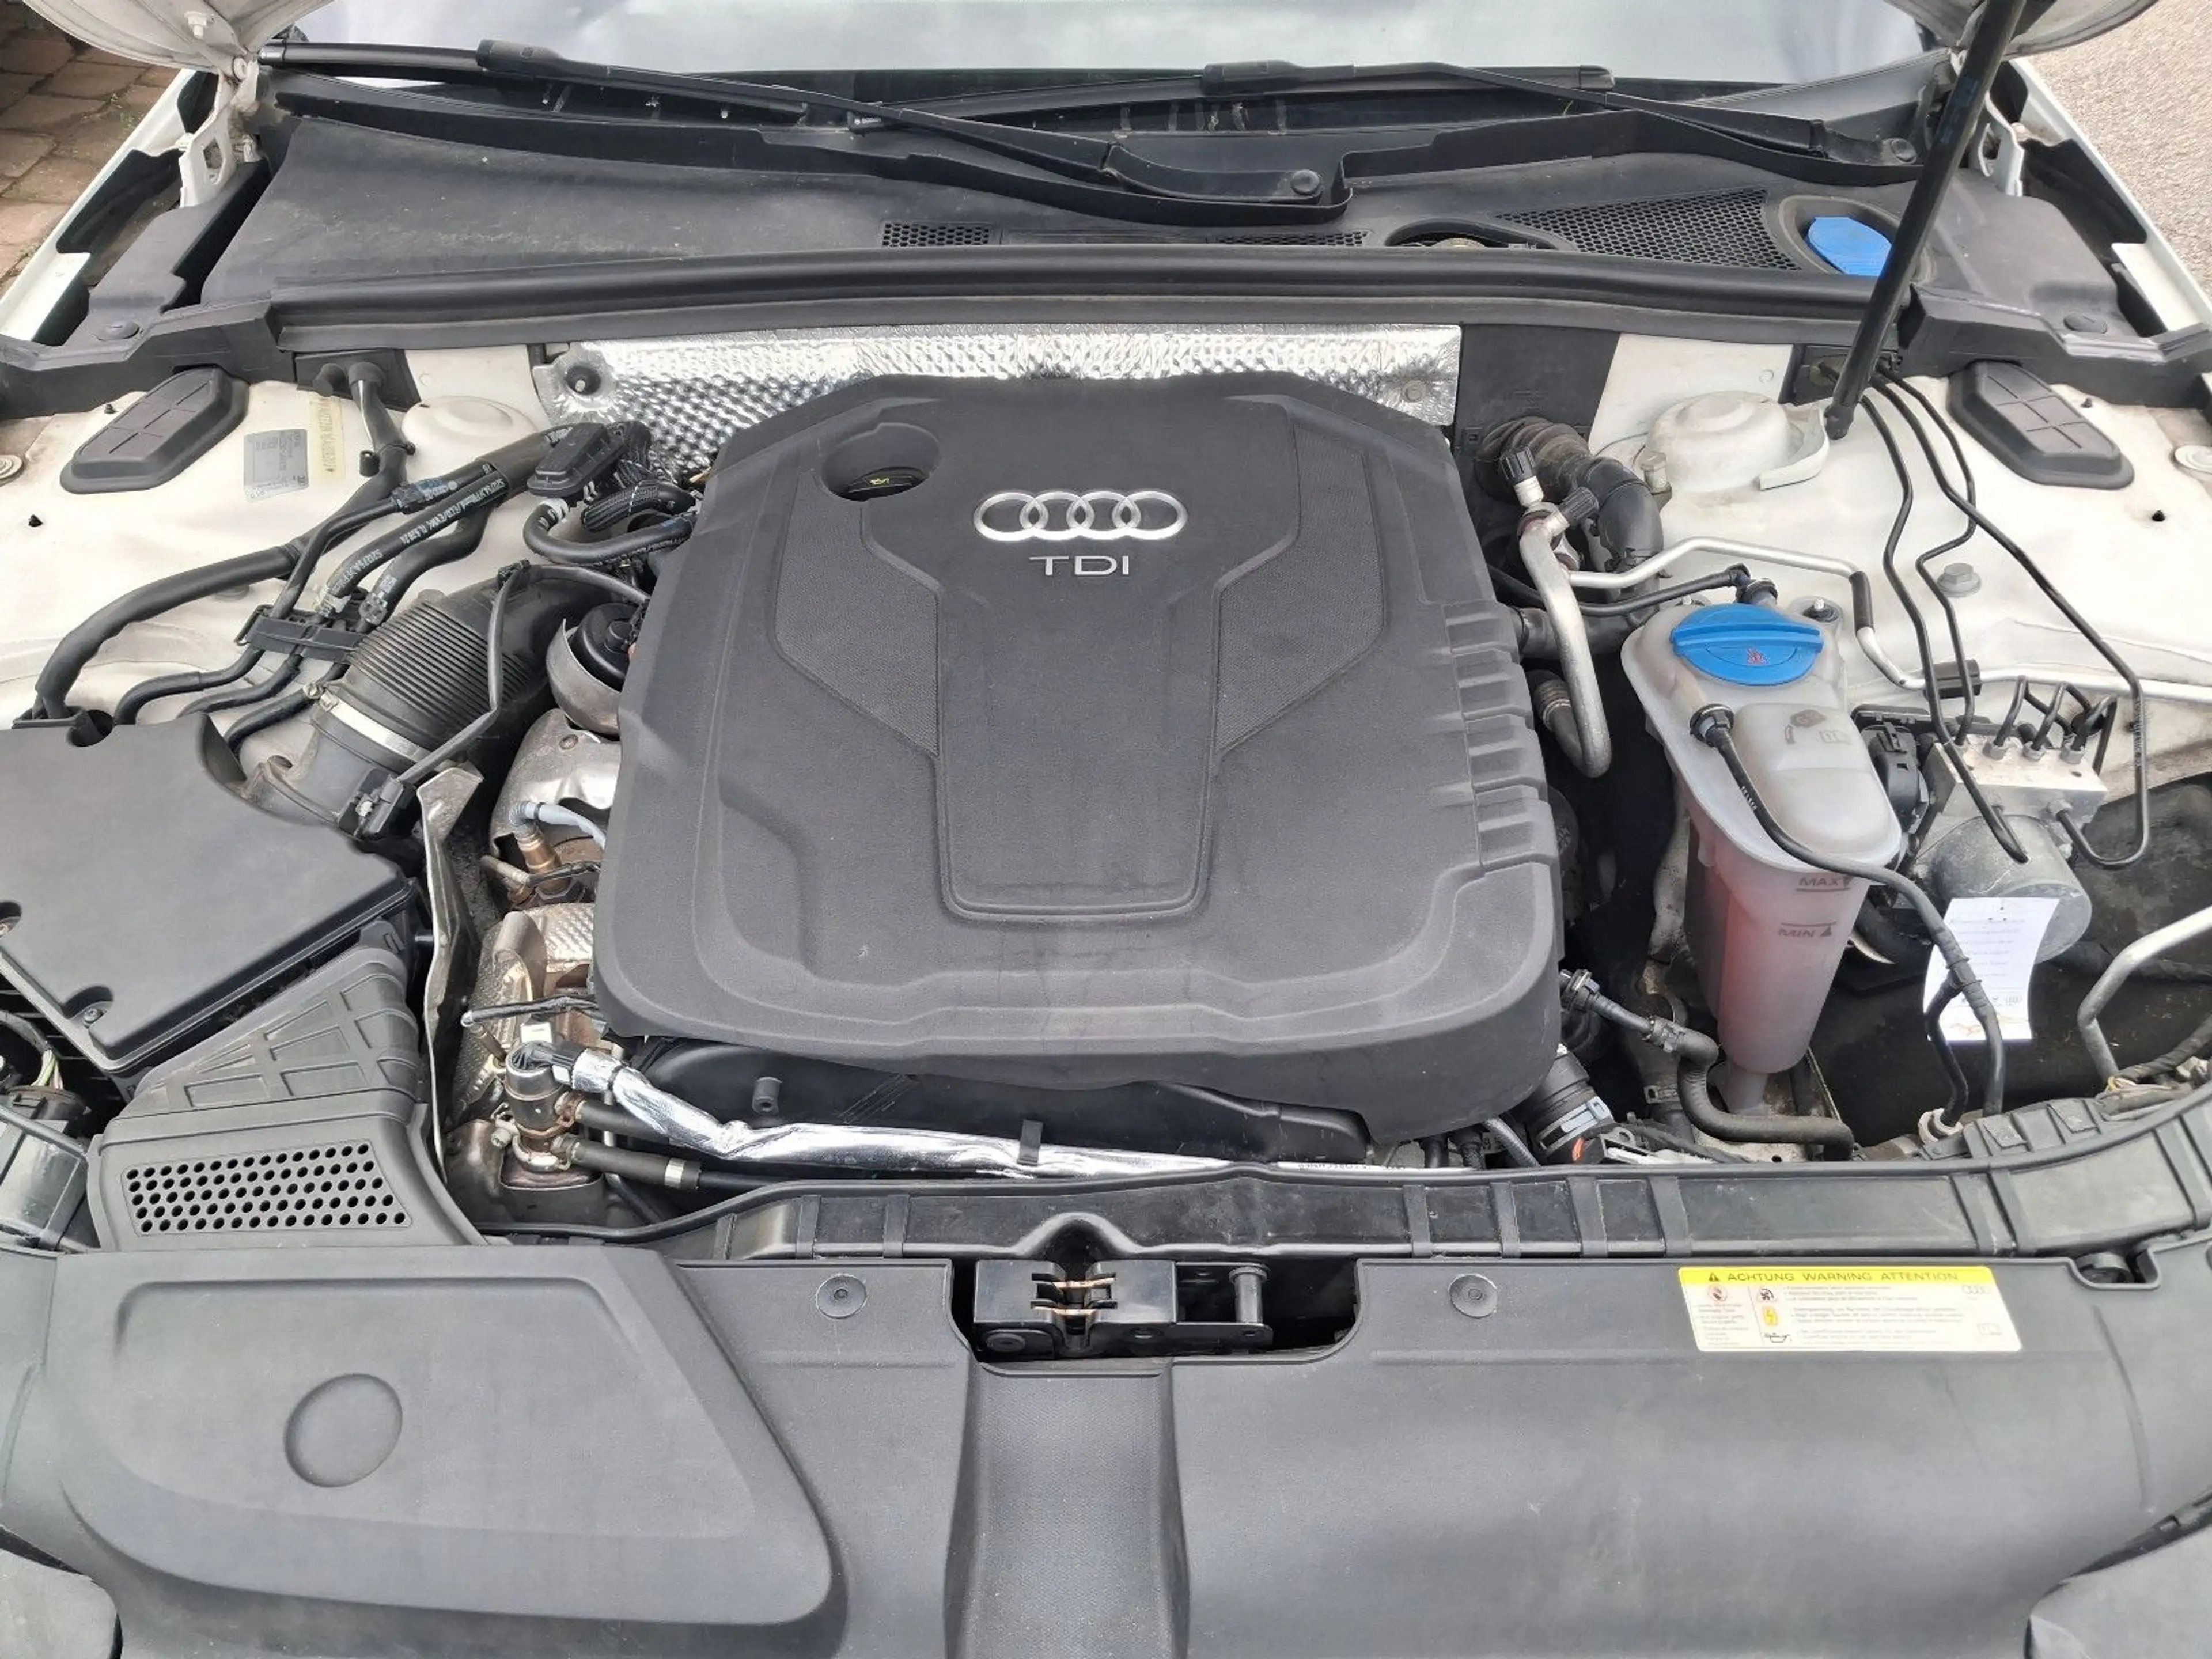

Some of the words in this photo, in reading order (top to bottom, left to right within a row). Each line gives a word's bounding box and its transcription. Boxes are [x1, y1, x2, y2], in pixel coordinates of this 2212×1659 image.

[1028, 555, 1130, 576] TDI
[1798, 877, 1842, 887] MAX
[1778, 927, 1816, 938] MIN
[1728, 1272, 1795, 1282] ACHTUNG
[1802, 1272, 1872, 1282] WARNING
[1881, 1271, 1959, 1281] ATTENTION
